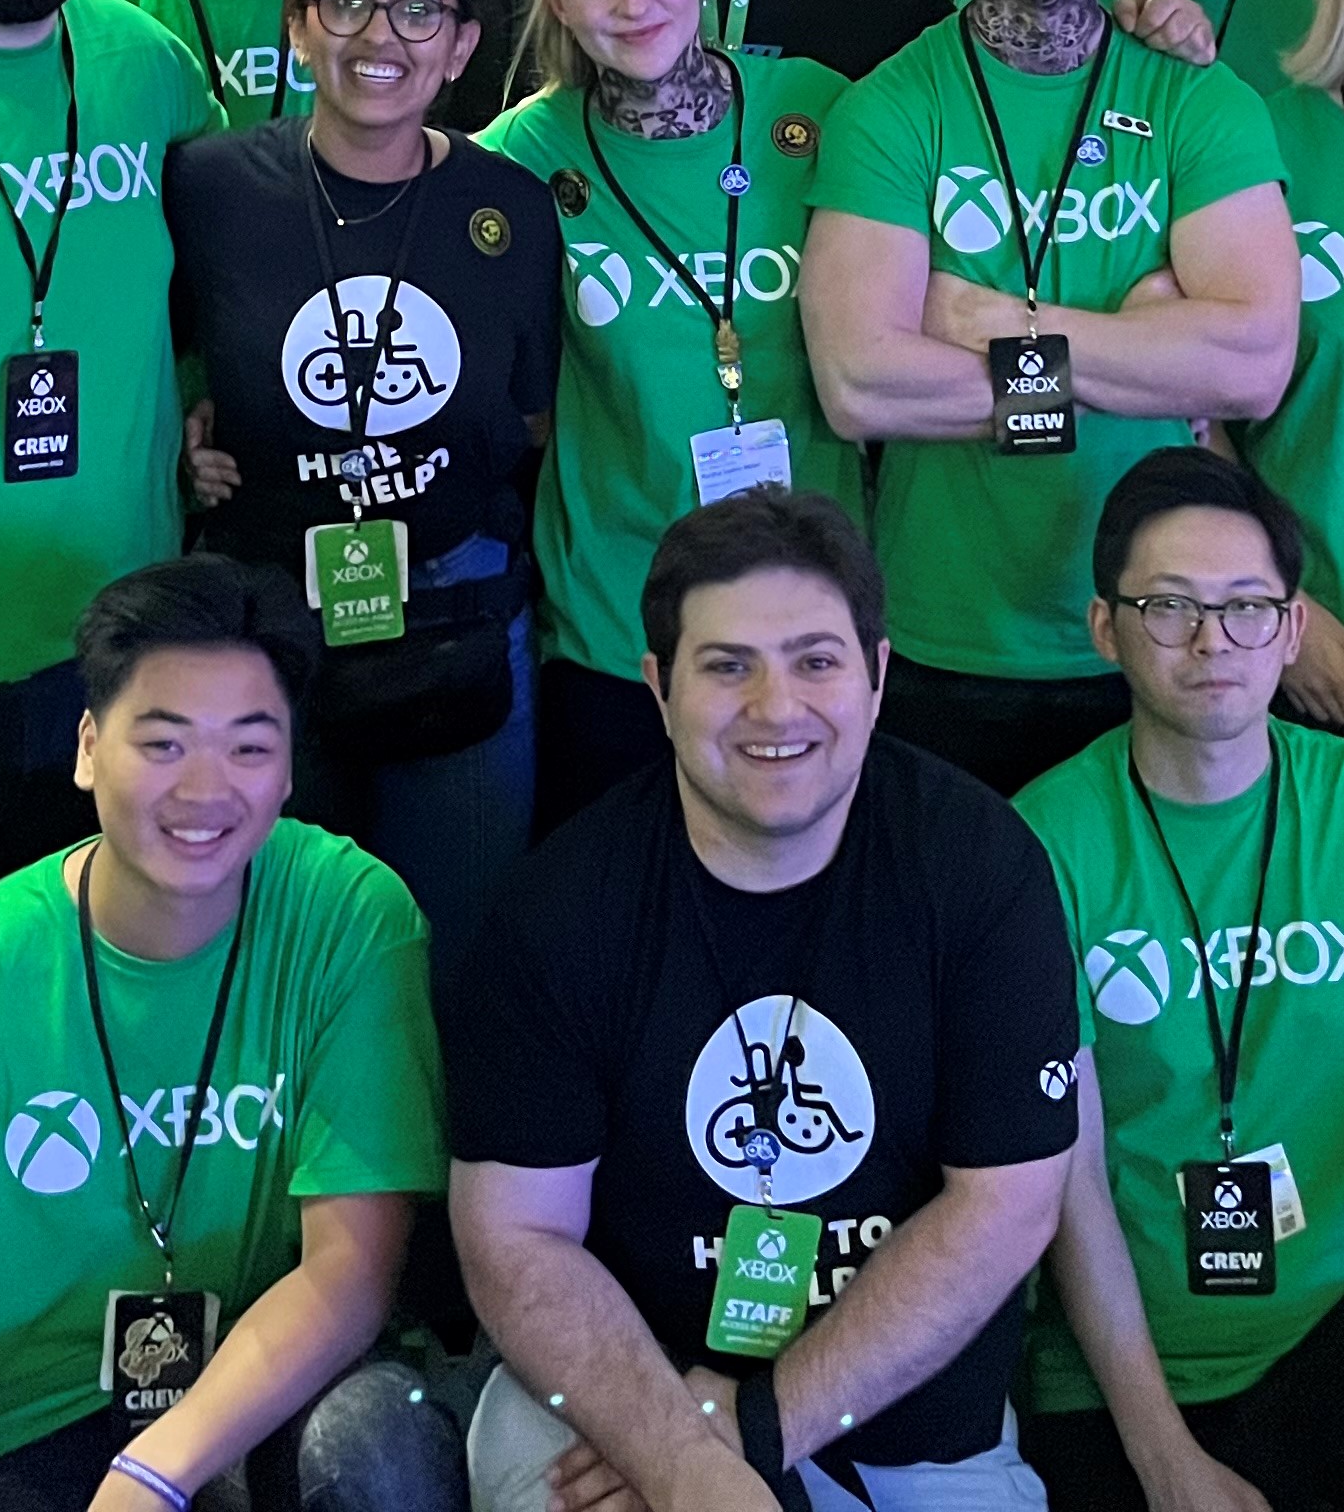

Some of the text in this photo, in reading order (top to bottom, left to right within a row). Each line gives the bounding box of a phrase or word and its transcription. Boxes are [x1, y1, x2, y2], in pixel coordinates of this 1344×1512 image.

[1, 142, 157, 219] XBOX
[1015, 178, 1160, 244] XBOX
[1006, 376, 1060, 394] XBOX
[17, 395, 66, 417] XBOX
[1007, 413, 1065, 431] CREW
[13, 434, 69, 456] CREW
[332, 562, 385, 585] XBOX
[333, 596, 391, 618] STAFF
[1200, 1210, 1259, 1230] XBOX
[735, 1257, 798, 1285] XBOX
[1199, 1252, 1263, 1272] CREW
[724, 1298, 793, 1326] STAFF
